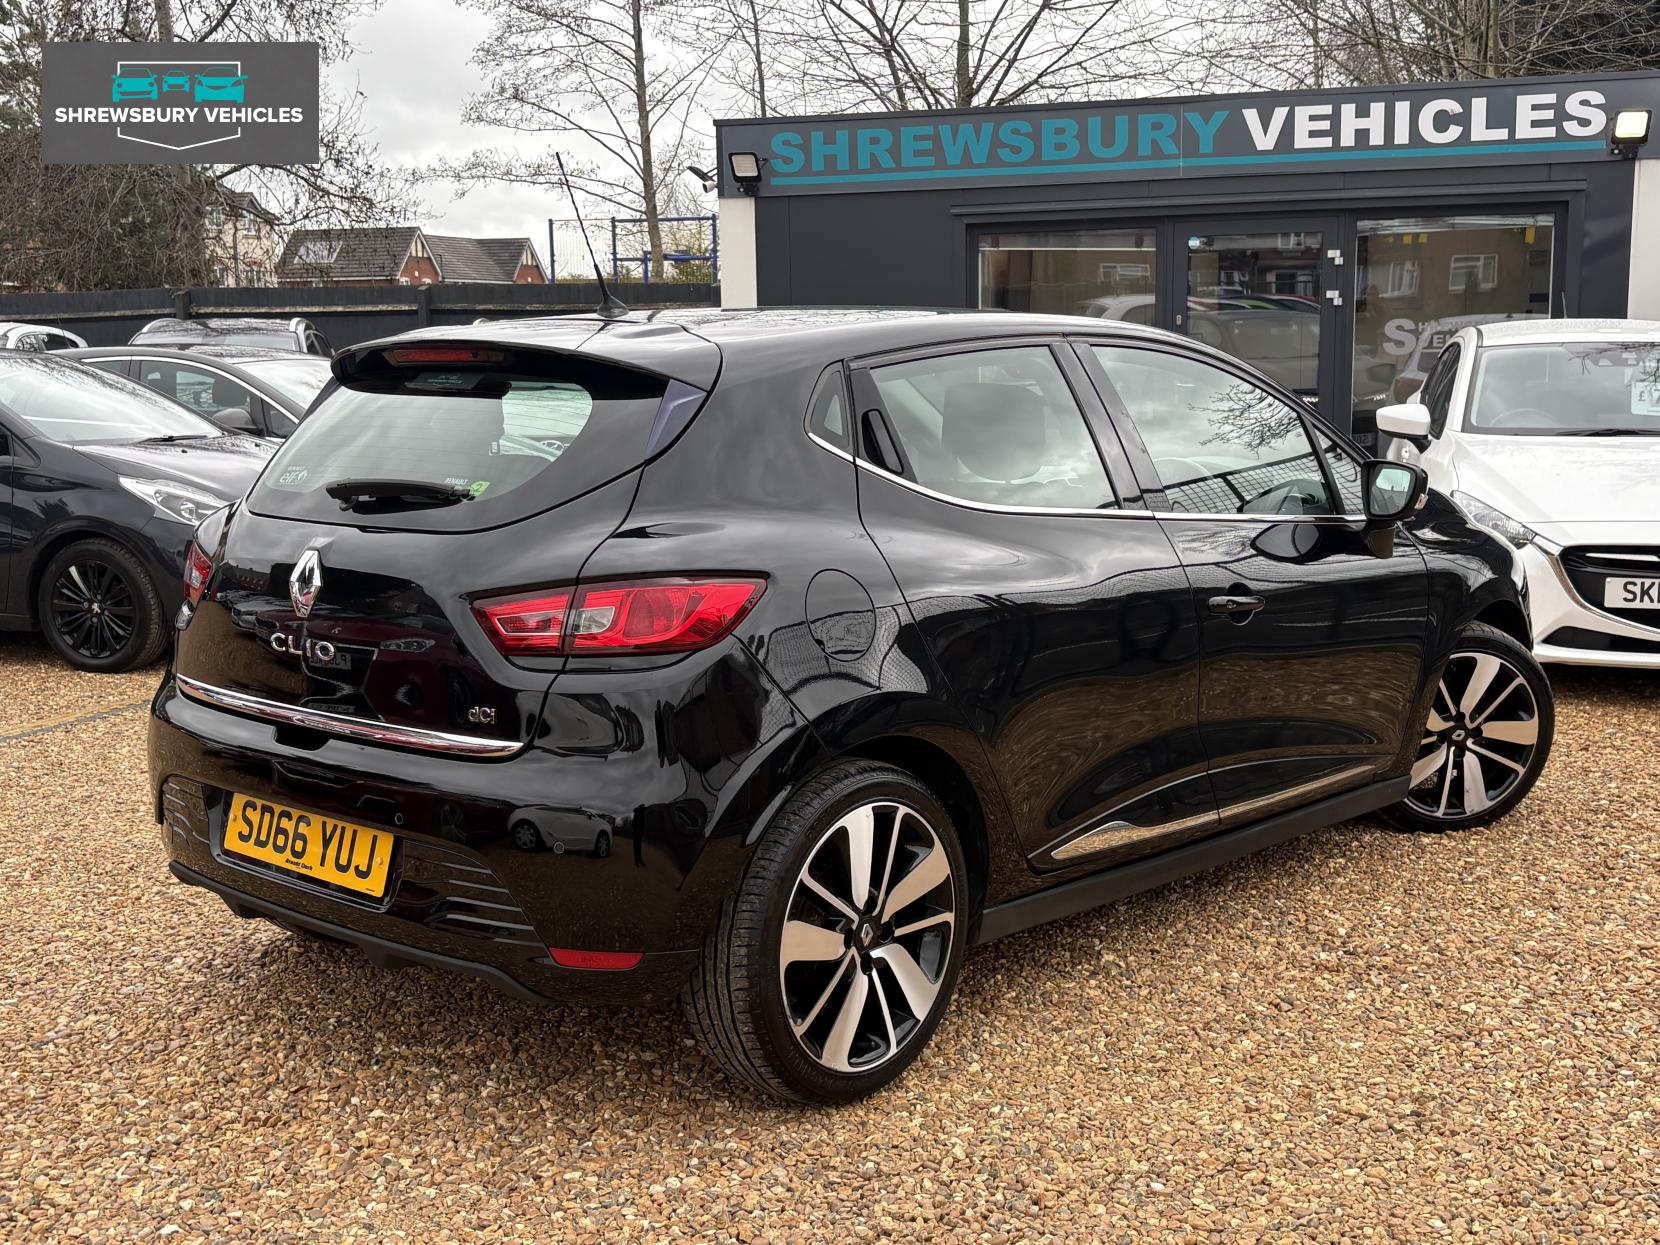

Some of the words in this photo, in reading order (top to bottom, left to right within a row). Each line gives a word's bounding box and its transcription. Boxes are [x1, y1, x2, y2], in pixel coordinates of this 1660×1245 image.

[769, 110, 1230, 173] SHREWSBURY
[1241, 90, 1607, 151] VEHICLES
[1622, 580, 1660, 604] SK
[270, 632, 335, 661] CLIO
[467, 706, 496, 725] dCi
[237, 799, 312, 860] SD66
[319, 820, 379, 880] YUJ
